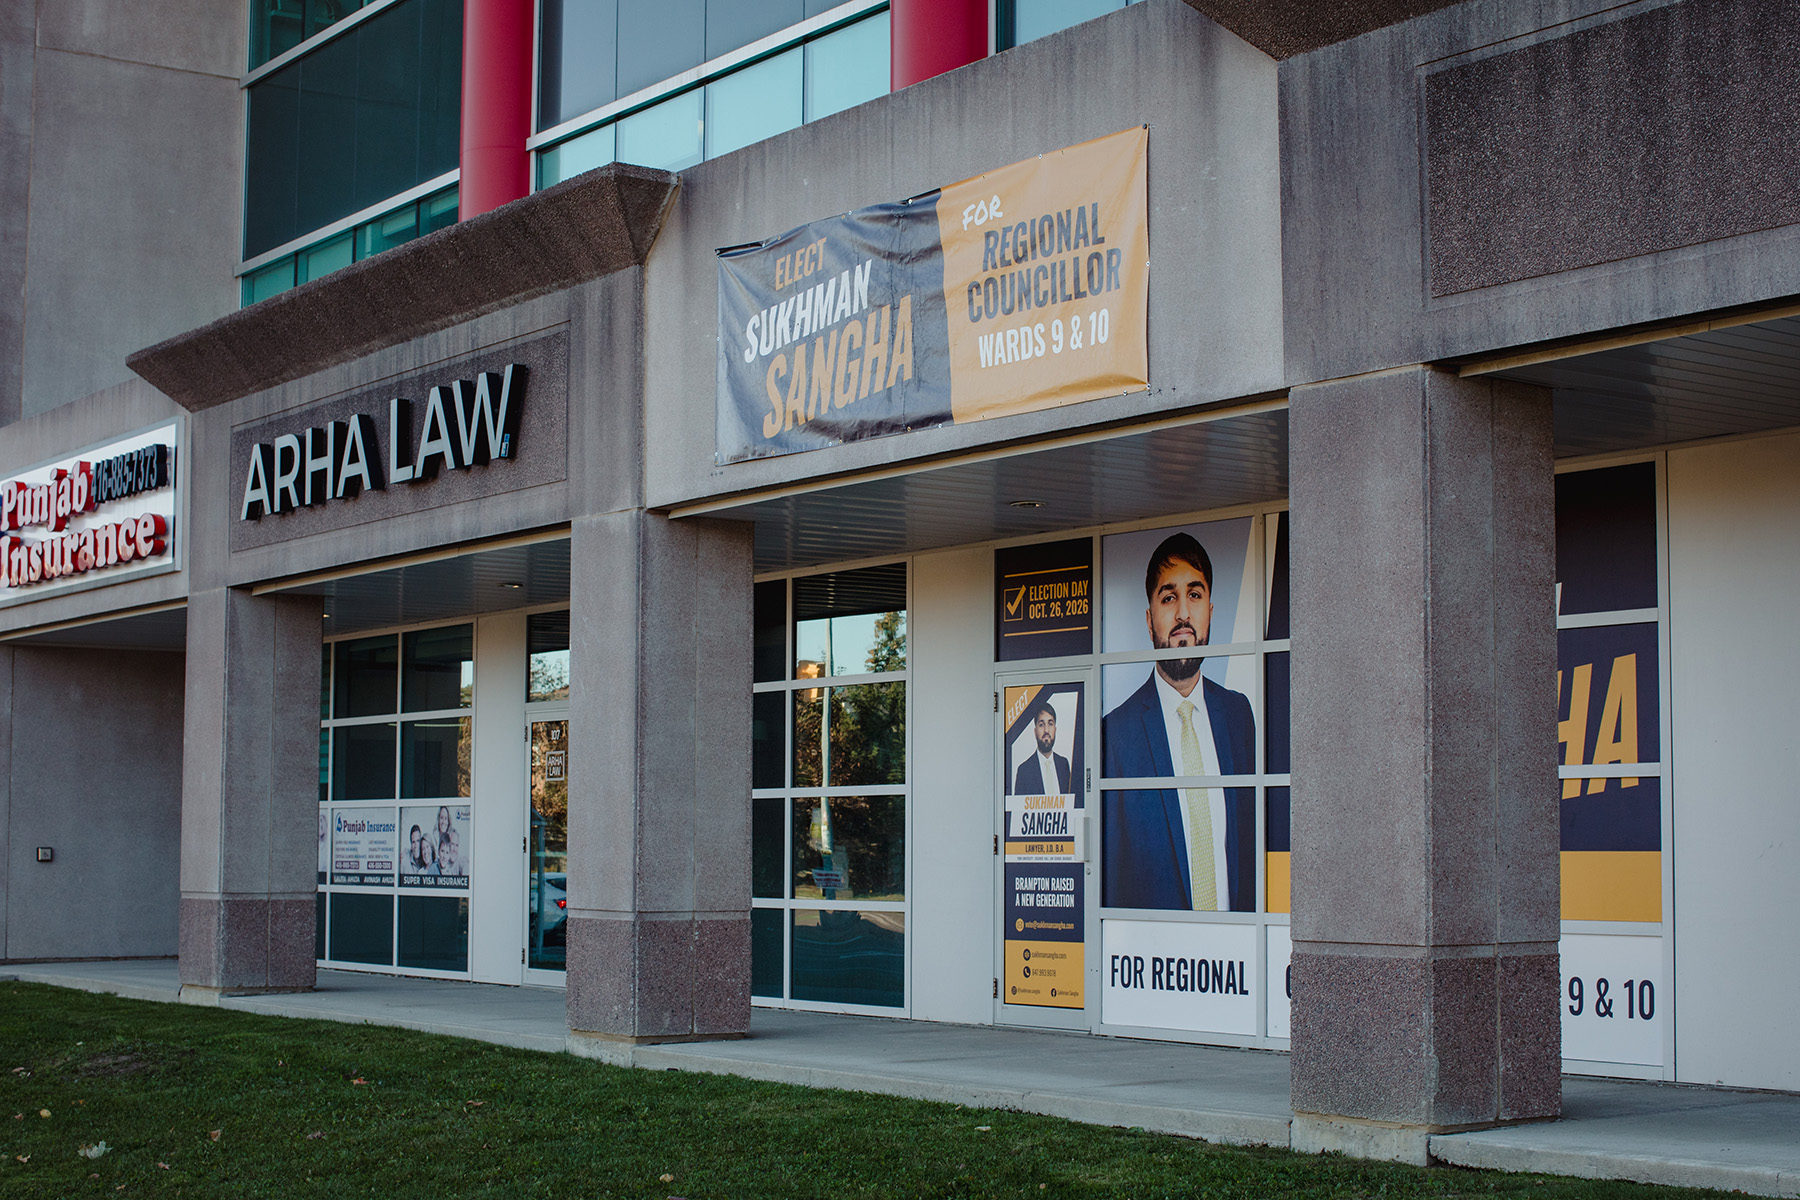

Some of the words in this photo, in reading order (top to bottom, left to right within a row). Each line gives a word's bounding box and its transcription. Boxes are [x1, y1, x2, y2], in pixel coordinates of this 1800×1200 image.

[962, 195, 1003, 231] FOR
[982, 202, 1105, 272] REGIONAL
[775, 237, 827, 291] ELECT
[967, 248, 1122, 323] COUNCILLOR
[744, 259, 872, 363] SUKHMAN
[978, 322, 1046, 368] WARDS
[1051, 319, 1064, 354] 9
[1070, 315, 1082, 350] &
[1089, 308, 1110, 346] 10
[762, 294, 913, 438] SANGHA
[241, 414, 374, 520] ARHA
[390, 364, 518, 484] LAW
[91, 444, 163, 502] 416-885-7373
[1, 461, 92, 532] Punjab
[0, 513, 158, 588] Insurance
[1029, 582, 1069, 602] ELECTION
[1071, 580, 1089, 597] DAY
[1029, 603, 1047, 619] OCT.
[1050, 601, 1063, 618] 26,
[1066, 599, 1088, 616] 2026
[1007, 689, 1029, 726] ELECT
[551, 729, 560, 740] 107
[548, 756, 562, 766] ARHA
[549, 766, 561, 776] LAW
[1024, 796, 1065, 810] SUKHMAN
[343, 820, 365, 835] Punjab
[367, 821, 395, 833] Insurance
[1021, 812, 1068, 836] SANGHA
[1025, 844, 1045, 853] LAWYER,
[403, 876, 420, 885] SUPER
[422, 876, 435, 885] VISA
[437, 877, 468, 886] INSURANCE
[1015, 877, 1050, 891] BRAMPTON
[1051, 878, 1074, 891] RAISED
[1015, 894, 1020, 906] A
[1021, 894, 1035, 907] NEW
[1036, 894, 1075, 908] GENERATION
[1111, 954, 1145, 989] FOR
[1152, 956, 1249, 995] REGIONAL
[1568, 976, 1584, 1017] 9
[1594, 977, 1614, 1018] &
[1623, 979, 1656, 1021] 10
